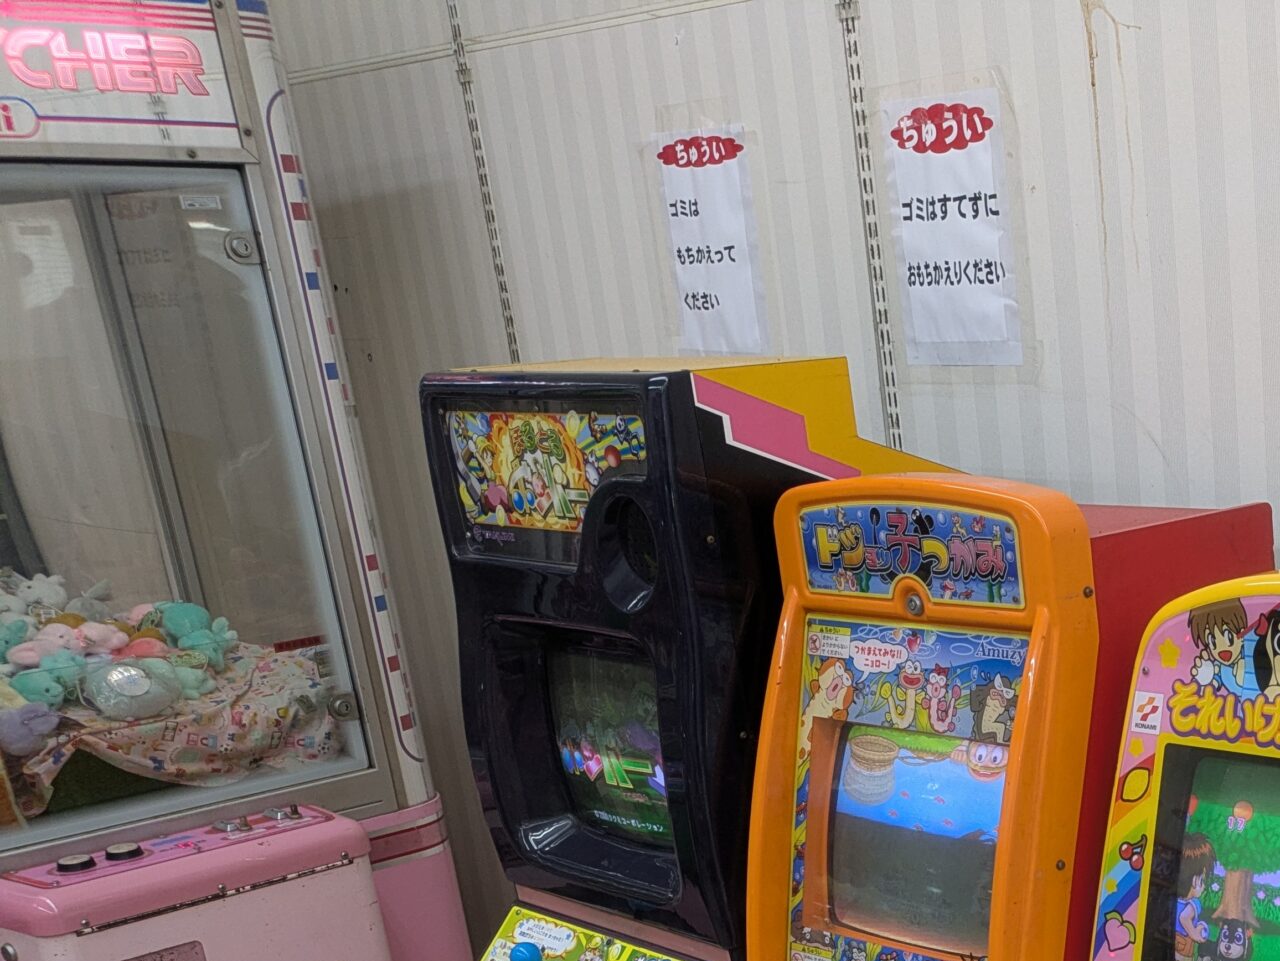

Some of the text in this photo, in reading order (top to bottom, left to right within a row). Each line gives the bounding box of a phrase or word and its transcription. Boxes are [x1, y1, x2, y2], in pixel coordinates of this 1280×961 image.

[0, 28, 210, 96] CHER
[901, 112, 983, 149] ちゅうい
[675, 138, 725, 166] ちゅうい
[669, 198, 700, 218] ゴミは
[902, 193, 1000, 222] ゴミはすてずに
[676, 245, 736, 265] もちかえって
[907, 260, 1006, 287] おもちかえりください
[684, 292, 720, 310] ください
[976, 641, 1026, 666] Amuzy
[1134, 722, 1157, 731] KONAMI
